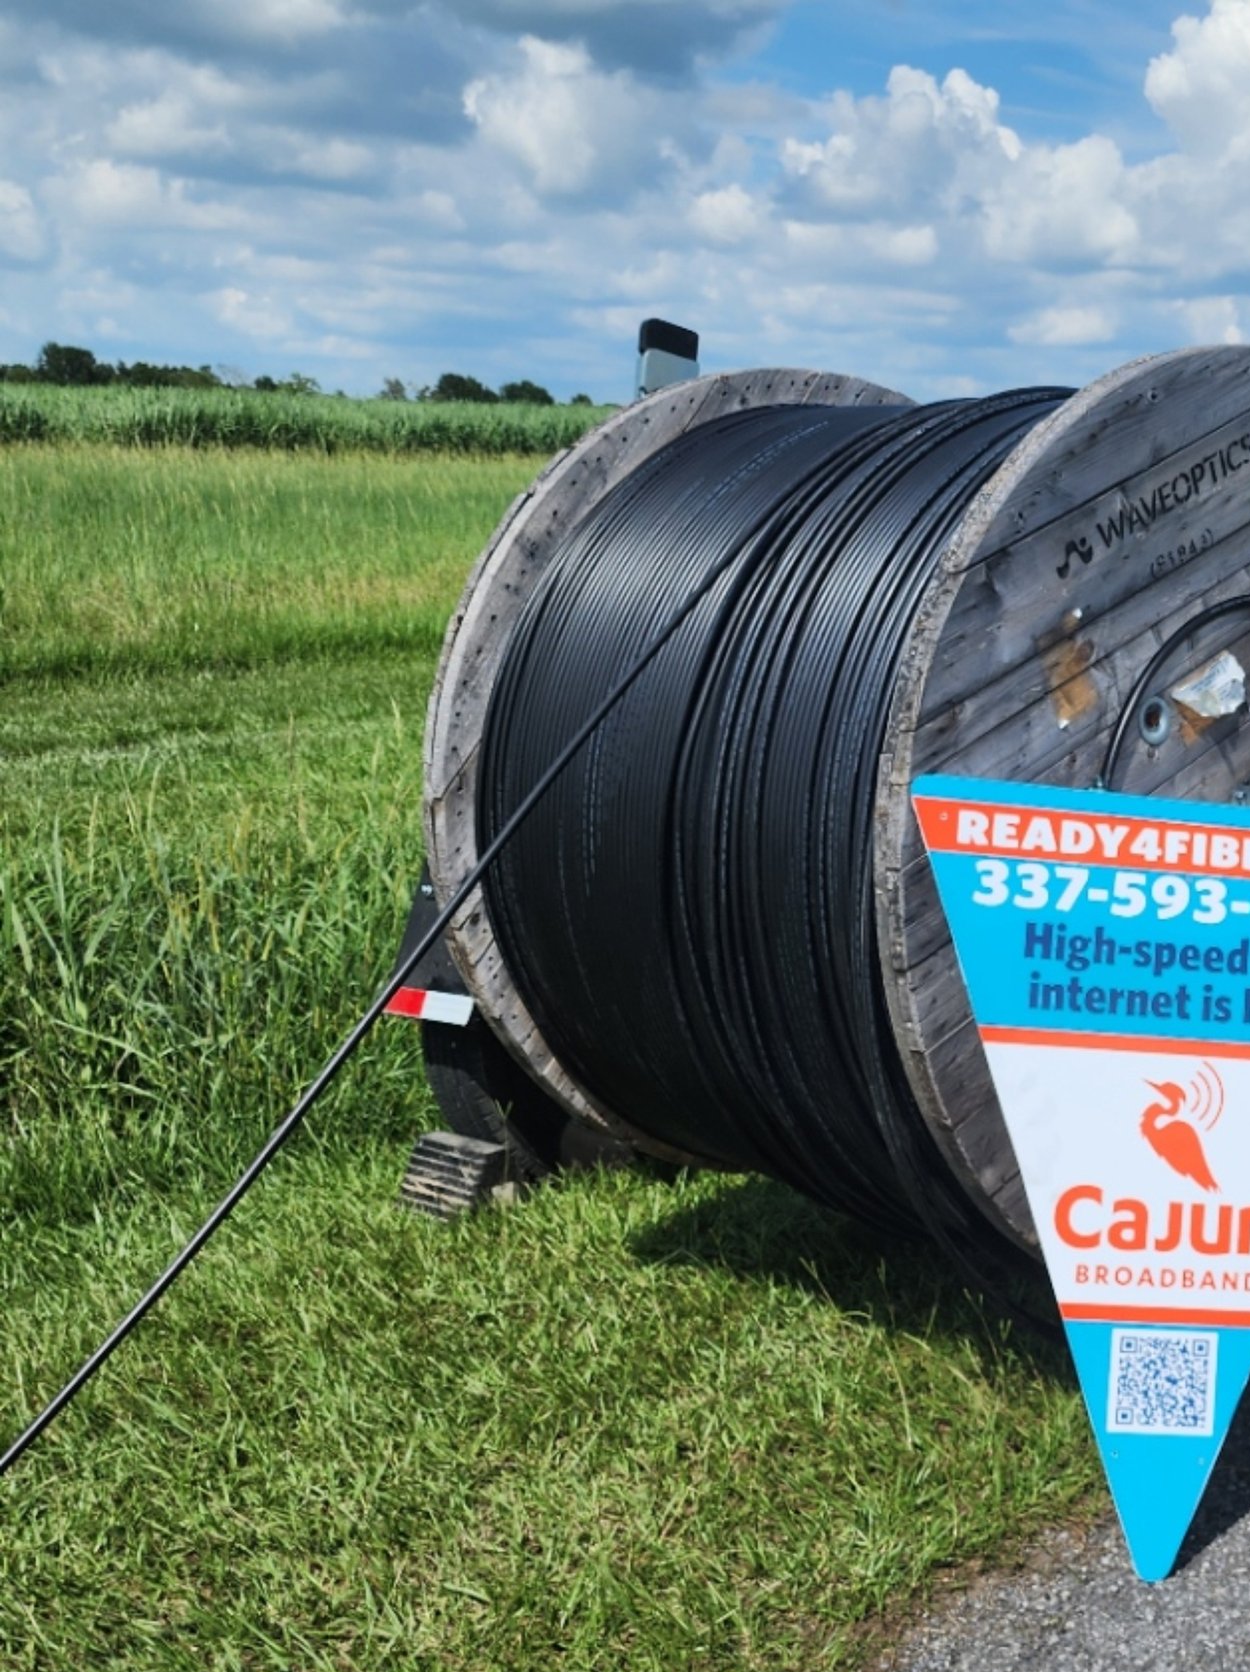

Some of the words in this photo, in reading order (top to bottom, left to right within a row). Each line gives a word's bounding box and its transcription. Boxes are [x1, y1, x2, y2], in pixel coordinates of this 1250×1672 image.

[1024, 923, 1249, 977] High-speed
[1029, 972, 1190, 1020] internet
[1203, 985, 1231, 1024] is
